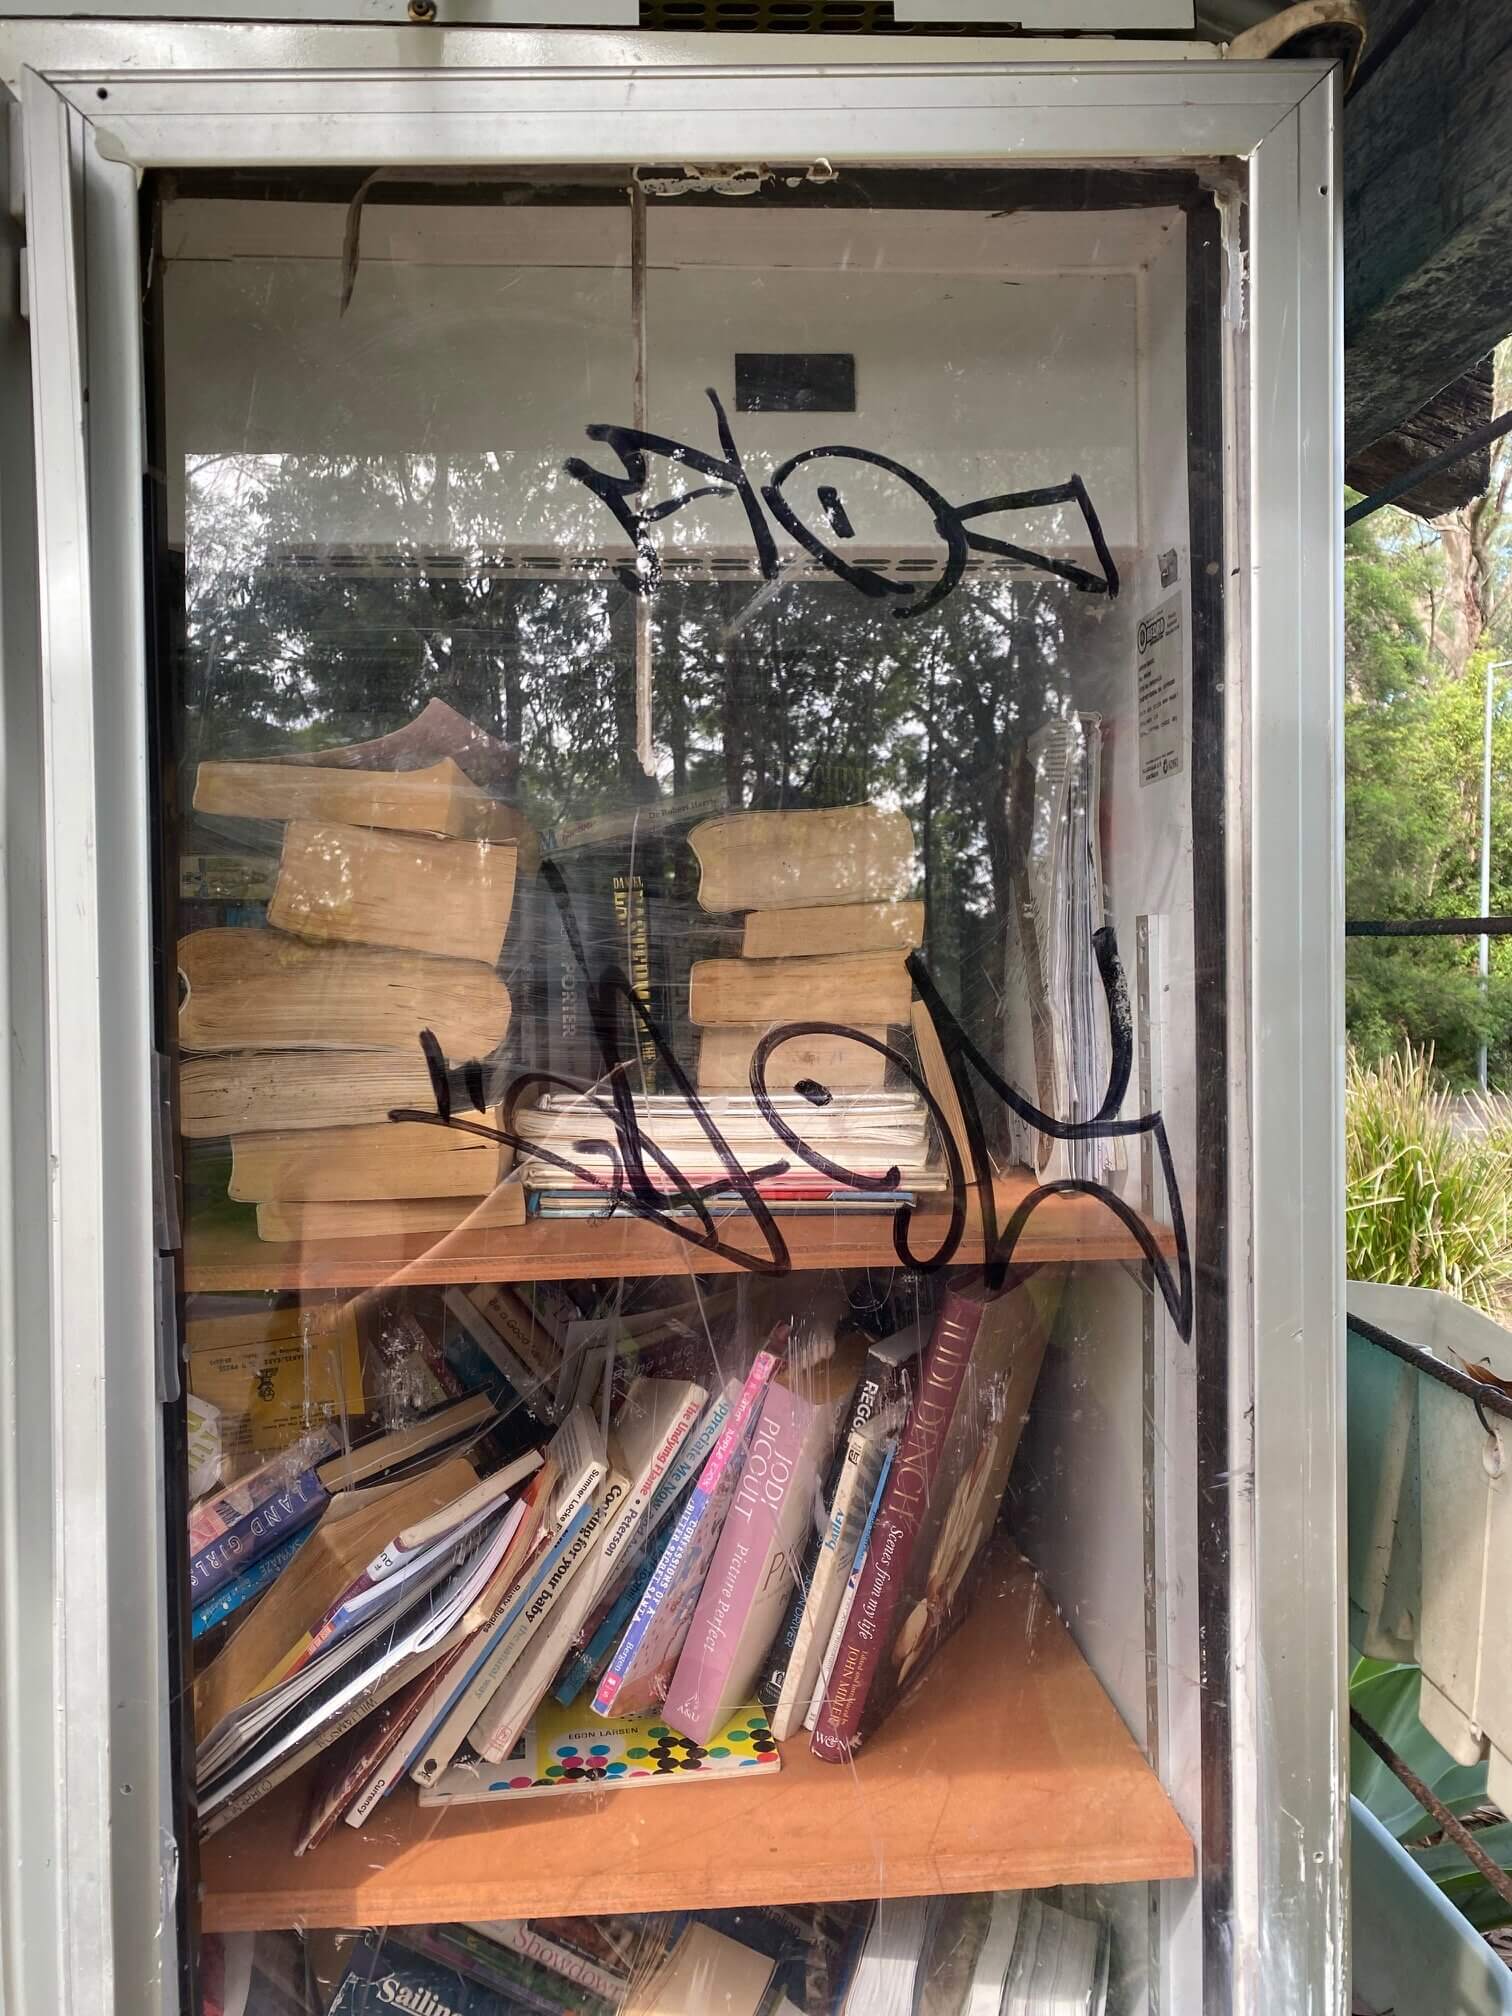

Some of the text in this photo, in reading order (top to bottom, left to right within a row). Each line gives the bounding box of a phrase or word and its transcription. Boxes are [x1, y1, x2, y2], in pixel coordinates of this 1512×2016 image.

[682, 1400, 700, 1421] The
[849, 1379, 879, 1435] REGG
[887, 1317, 970, 1519] JUDI DENCH
[655, 1420, 689, 1464] Undying
[638, 1462, 663, 1497] Flame
[672, 1461, 691, 1482] Me
[732, 1416, 780, 1521] PICOULT
[759, 1450, 793, 1509] JODI
[558, 1467, 600, 1523] Sumner Locke
[579, 1482, 624, 1540] Cooking
[650, 1479, 677, 1511] Now
[567, 1534, 587, 1560] for
[603, 1507, 638, 1558] Peterson
[547, 1556, 573, 1590] your
[856, 1524, 905, 1642] Scenes from my life
[525, 1588, 554, 1623] baby
[632, 1584, 656, 1623] SANTA
[702, 1543, 749, 1653] Picture Perfect
[611, 1640, 635, 1672] Bergen
[841, 1645, 860, 1679] JOHN
[830, 1680, 848, 1724] MILLER
[568, 1726, 640, 1741] EGON LARSEN
[355, 1777, 387, 1814] Currency
[376, 1979, 463, 2016] Sailin
